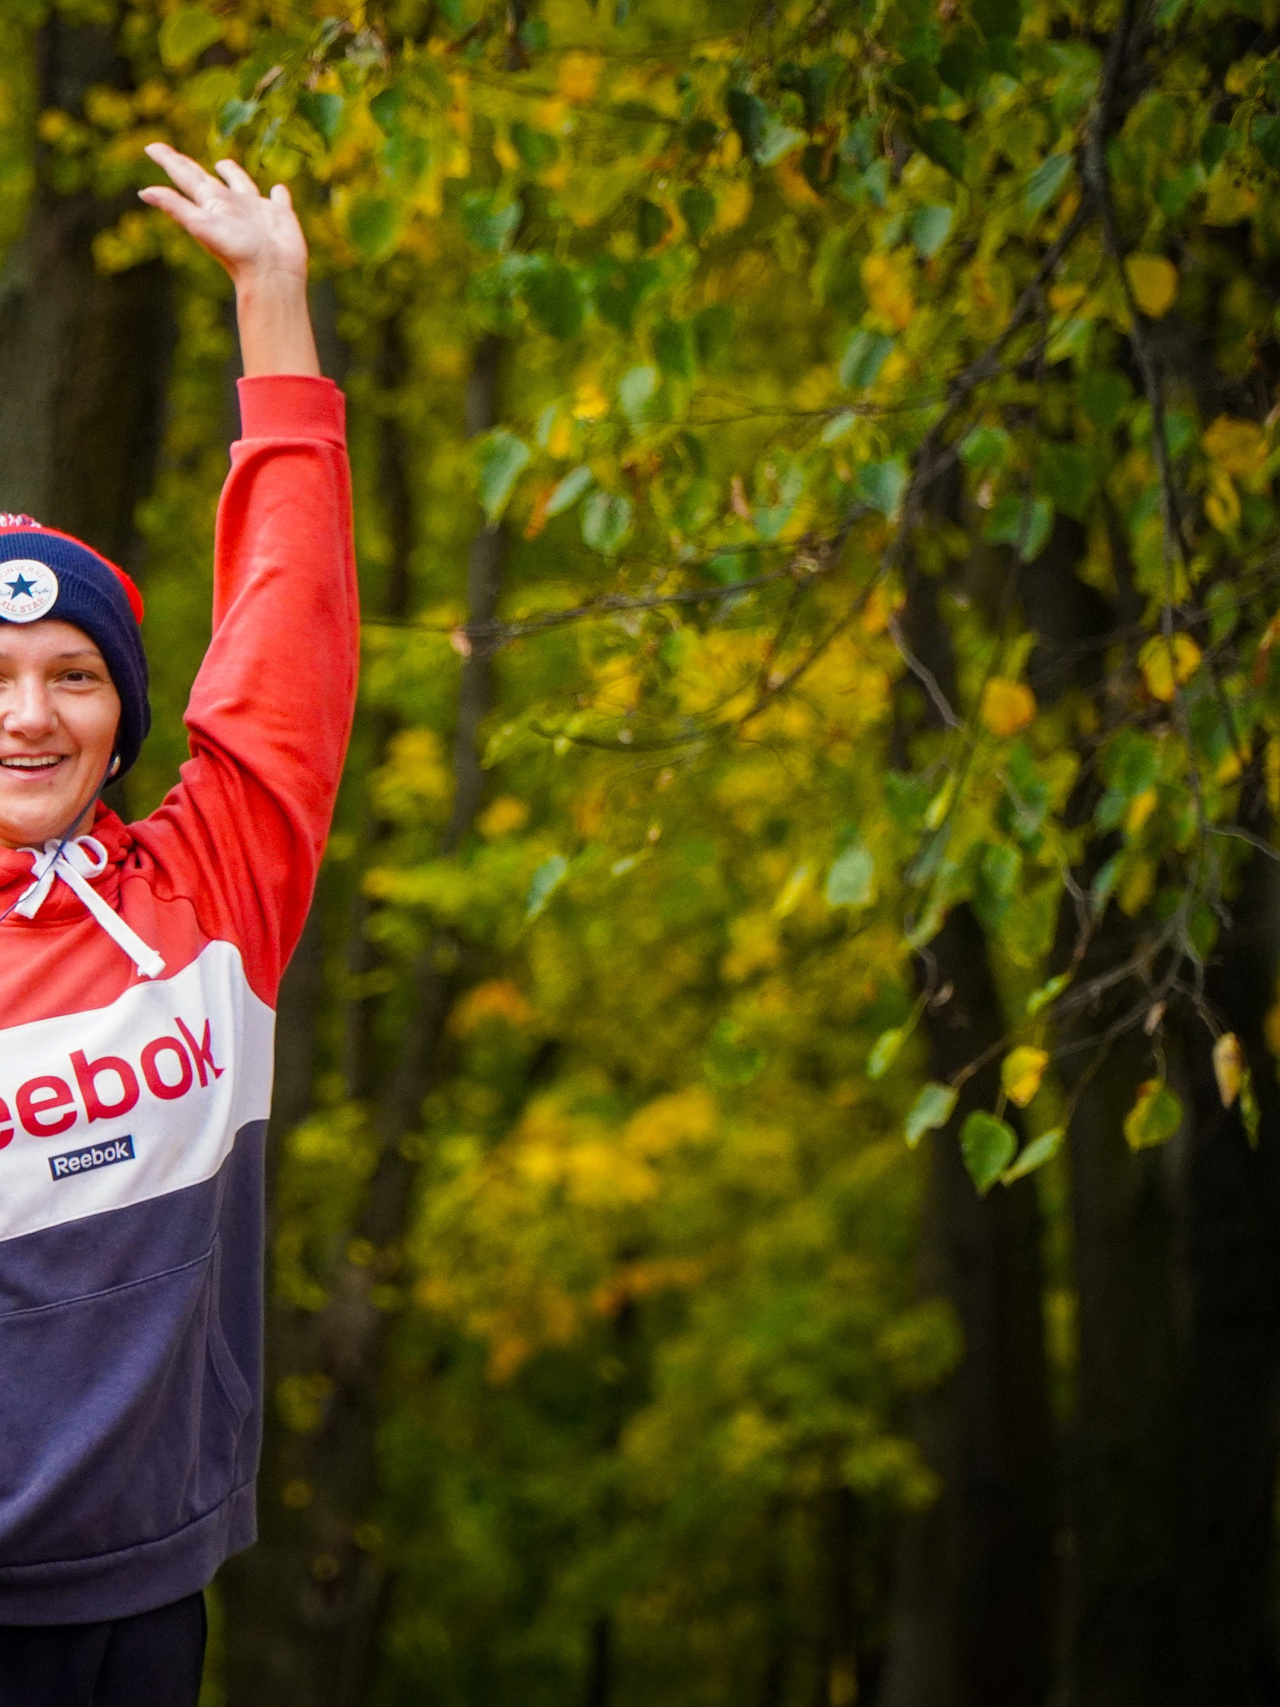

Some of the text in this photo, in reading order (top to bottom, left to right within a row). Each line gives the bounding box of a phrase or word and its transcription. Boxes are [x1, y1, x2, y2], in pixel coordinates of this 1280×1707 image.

[0, 597, 46, 613] ALL STAR
[53, 1141, 129, 1176] Reebok
